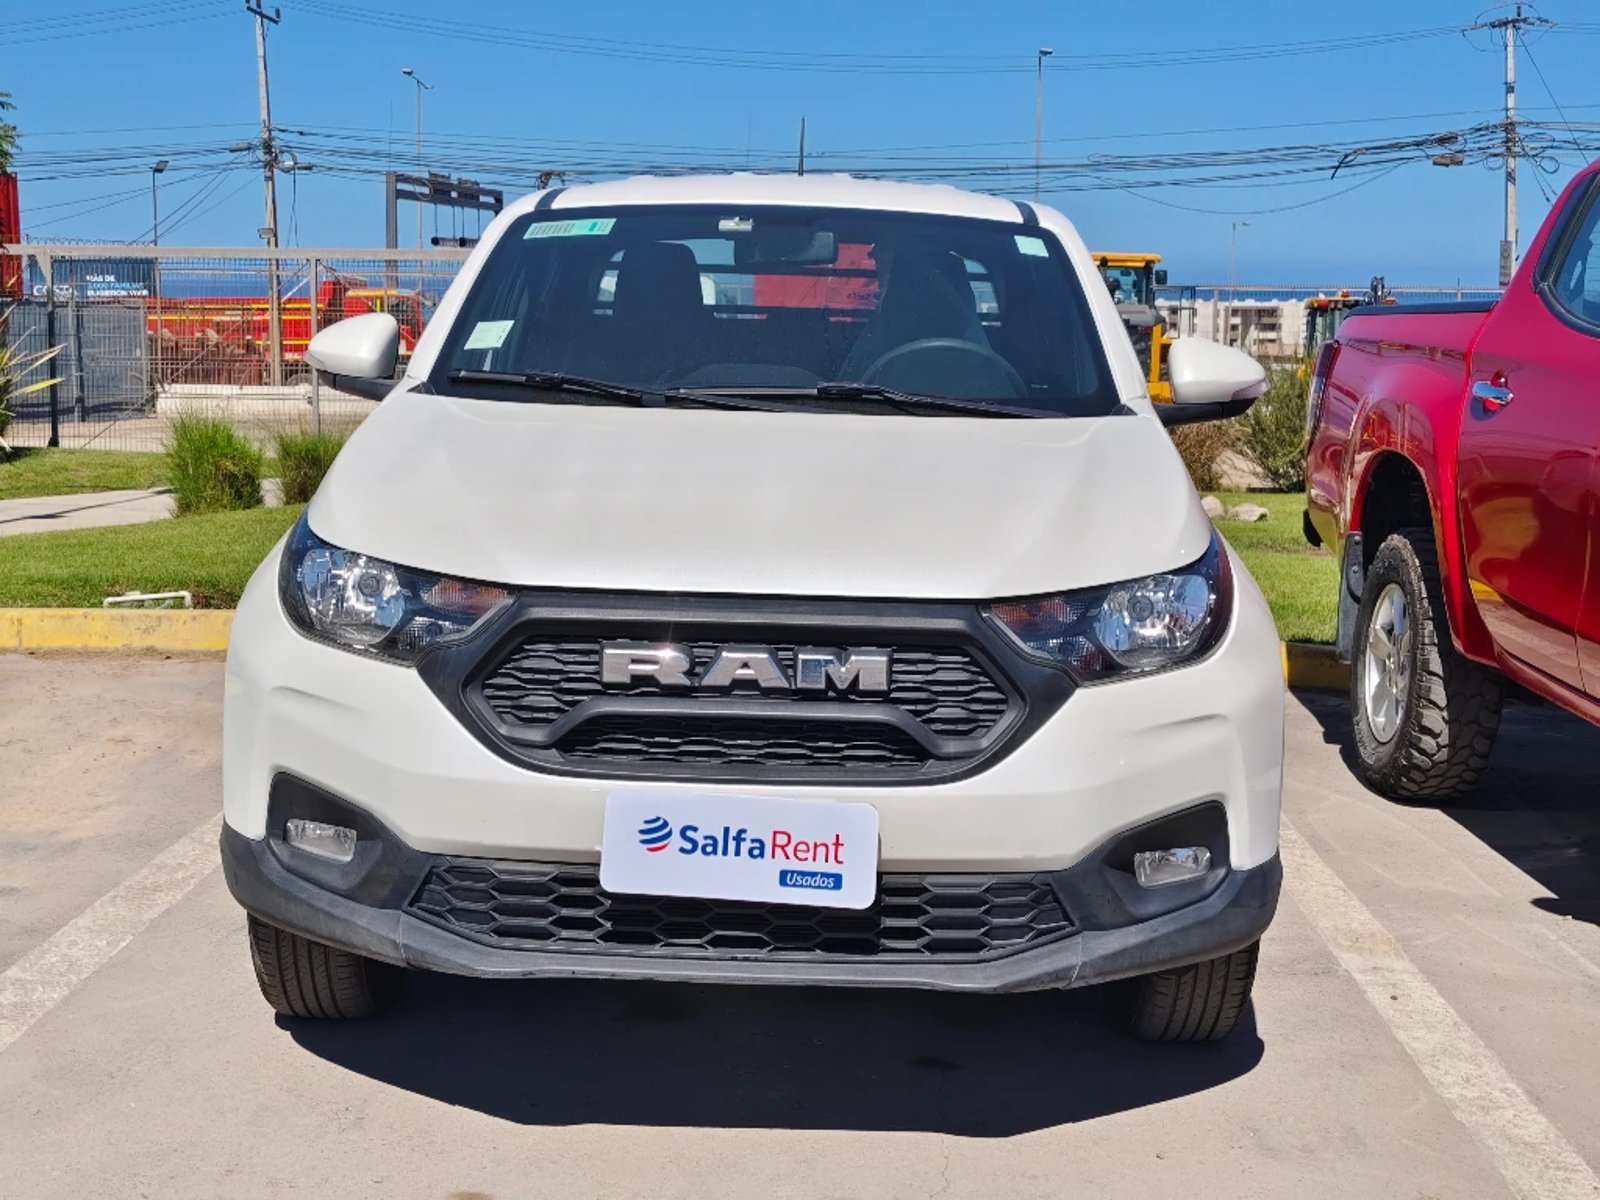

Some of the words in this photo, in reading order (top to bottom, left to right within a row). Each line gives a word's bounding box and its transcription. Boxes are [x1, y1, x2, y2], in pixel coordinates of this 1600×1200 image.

[601, 643, 890, 692] RAM
[678, 825, 845, 864] SalfaRent
[786, 872, 835, 888] Usados
